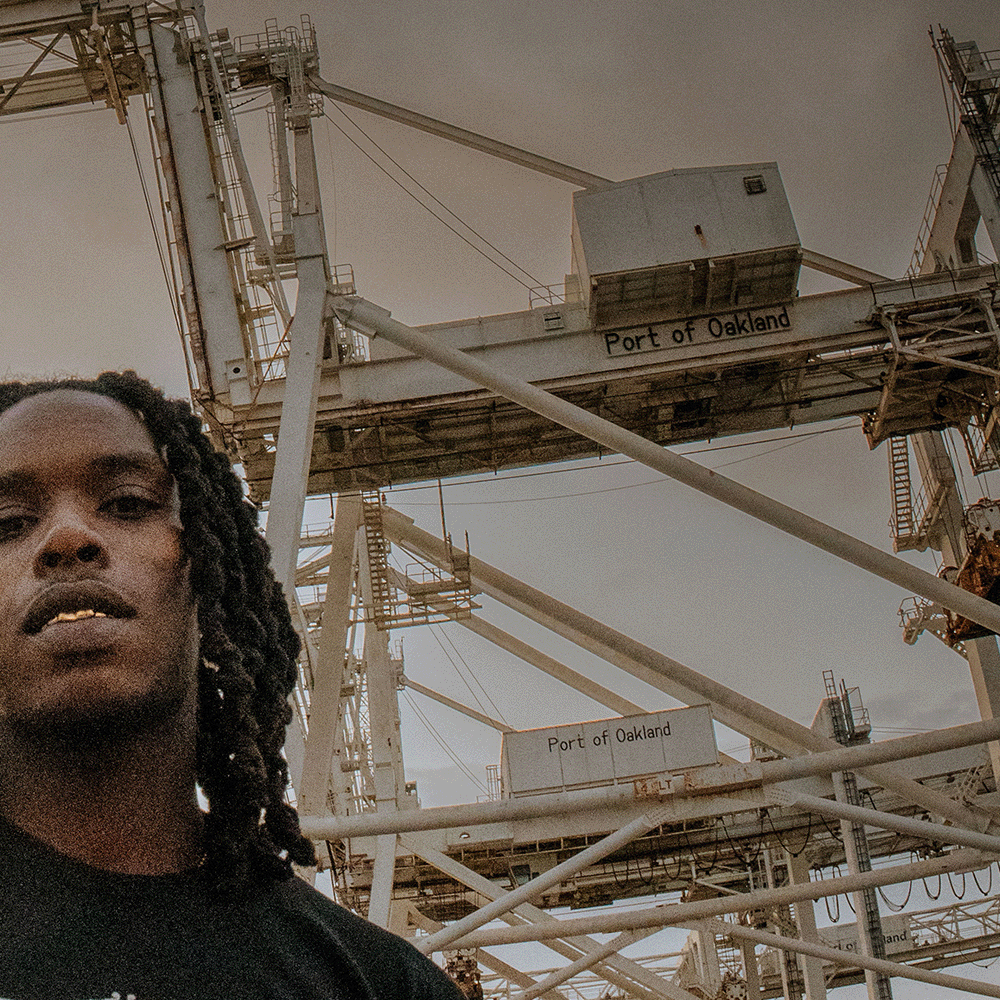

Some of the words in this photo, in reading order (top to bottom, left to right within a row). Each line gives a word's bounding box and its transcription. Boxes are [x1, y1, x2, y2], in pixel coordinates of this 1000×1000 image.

[604, 327, 661, 355] Port
[672, 321, 696, 343] of
[708, 306, 791, 338] Oakland
[547, 734, 585, 753] Port
[592, 729, 609, 747] of
[615, 721, 672, 743] Oakland
